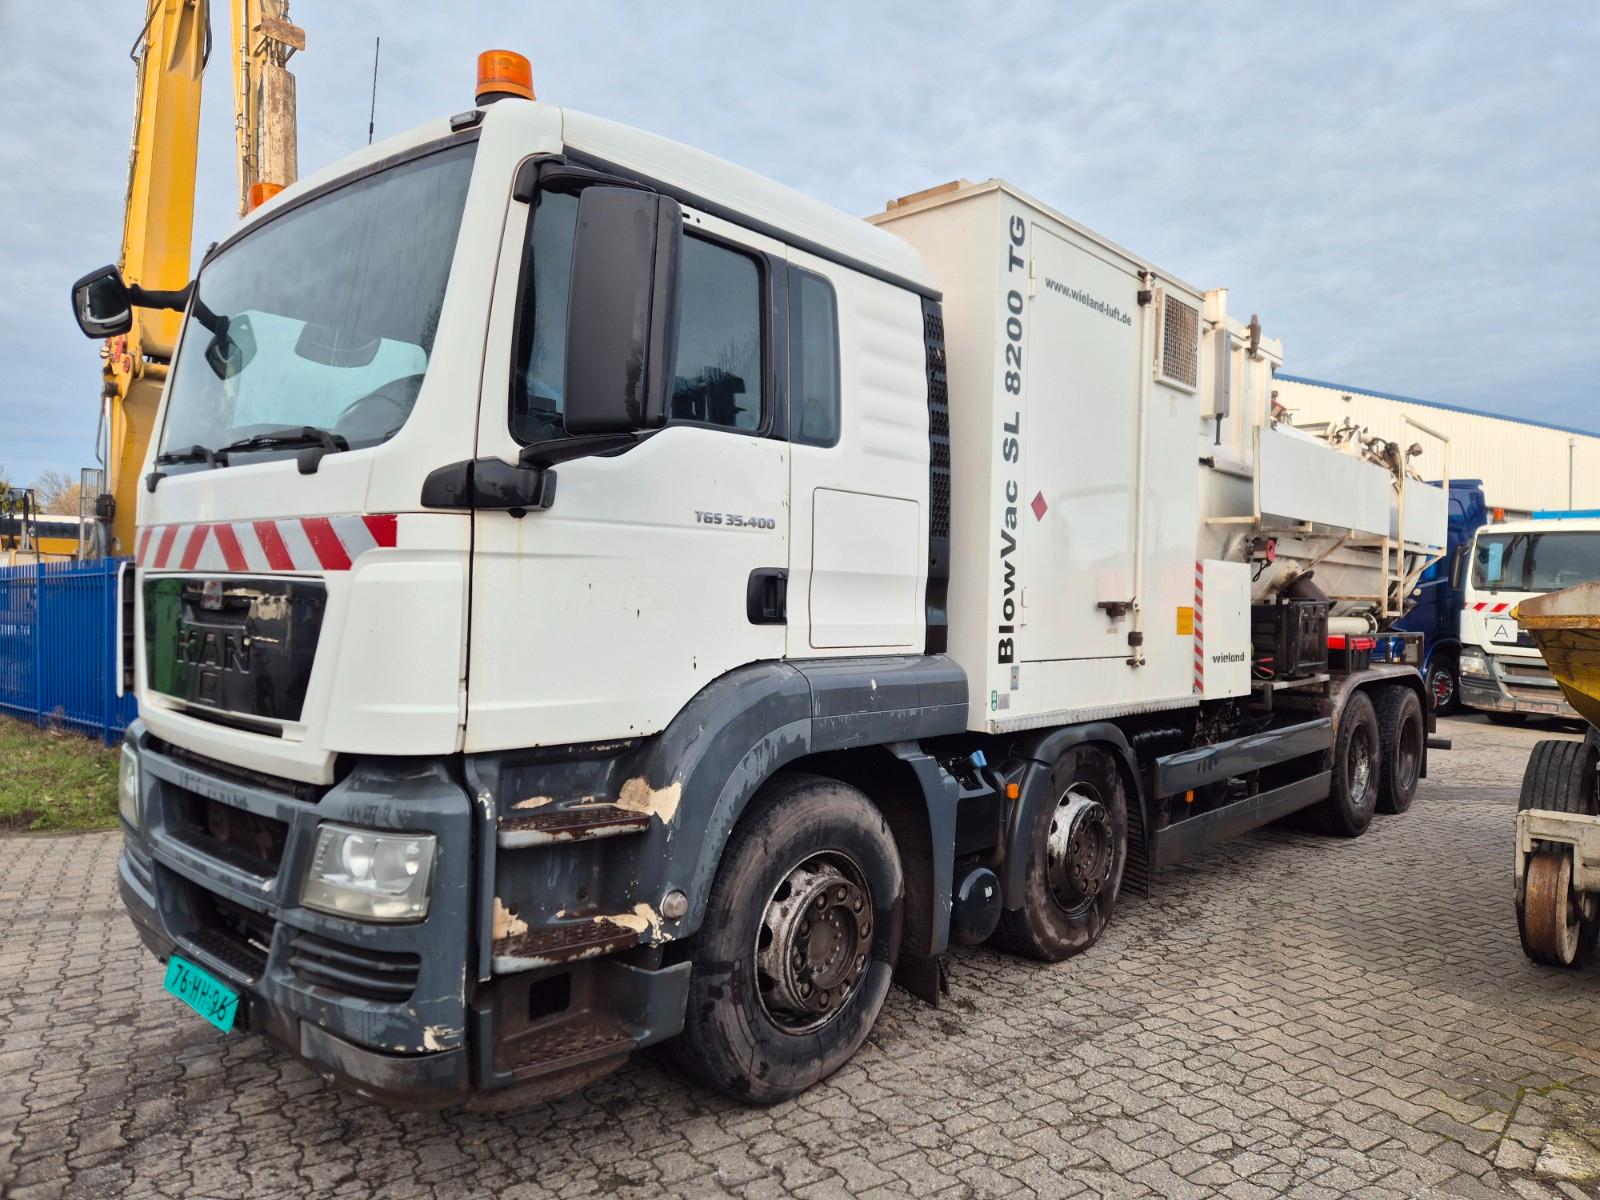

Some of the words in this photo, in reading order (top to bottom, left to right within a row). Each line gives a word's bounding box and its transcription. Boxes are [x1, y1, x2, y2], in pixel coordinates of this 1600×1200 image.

[1008, 215, 1026, 273] TG
[1045, 277, 1132, 326] www.wieland-luft.de
[1005, 289, 1023, 396] 8200
[1002, 411, 1020, 464] SL
[694, 510, 722, 525] TGS
[725, 514, 776, 530] 35.400
[998, 480, 1018, 664] BlowVac
[176, 629, 250, 674] MAN
[1494, 624, 1509, 638] A
[1212, 651, 1245, 663] wieland
